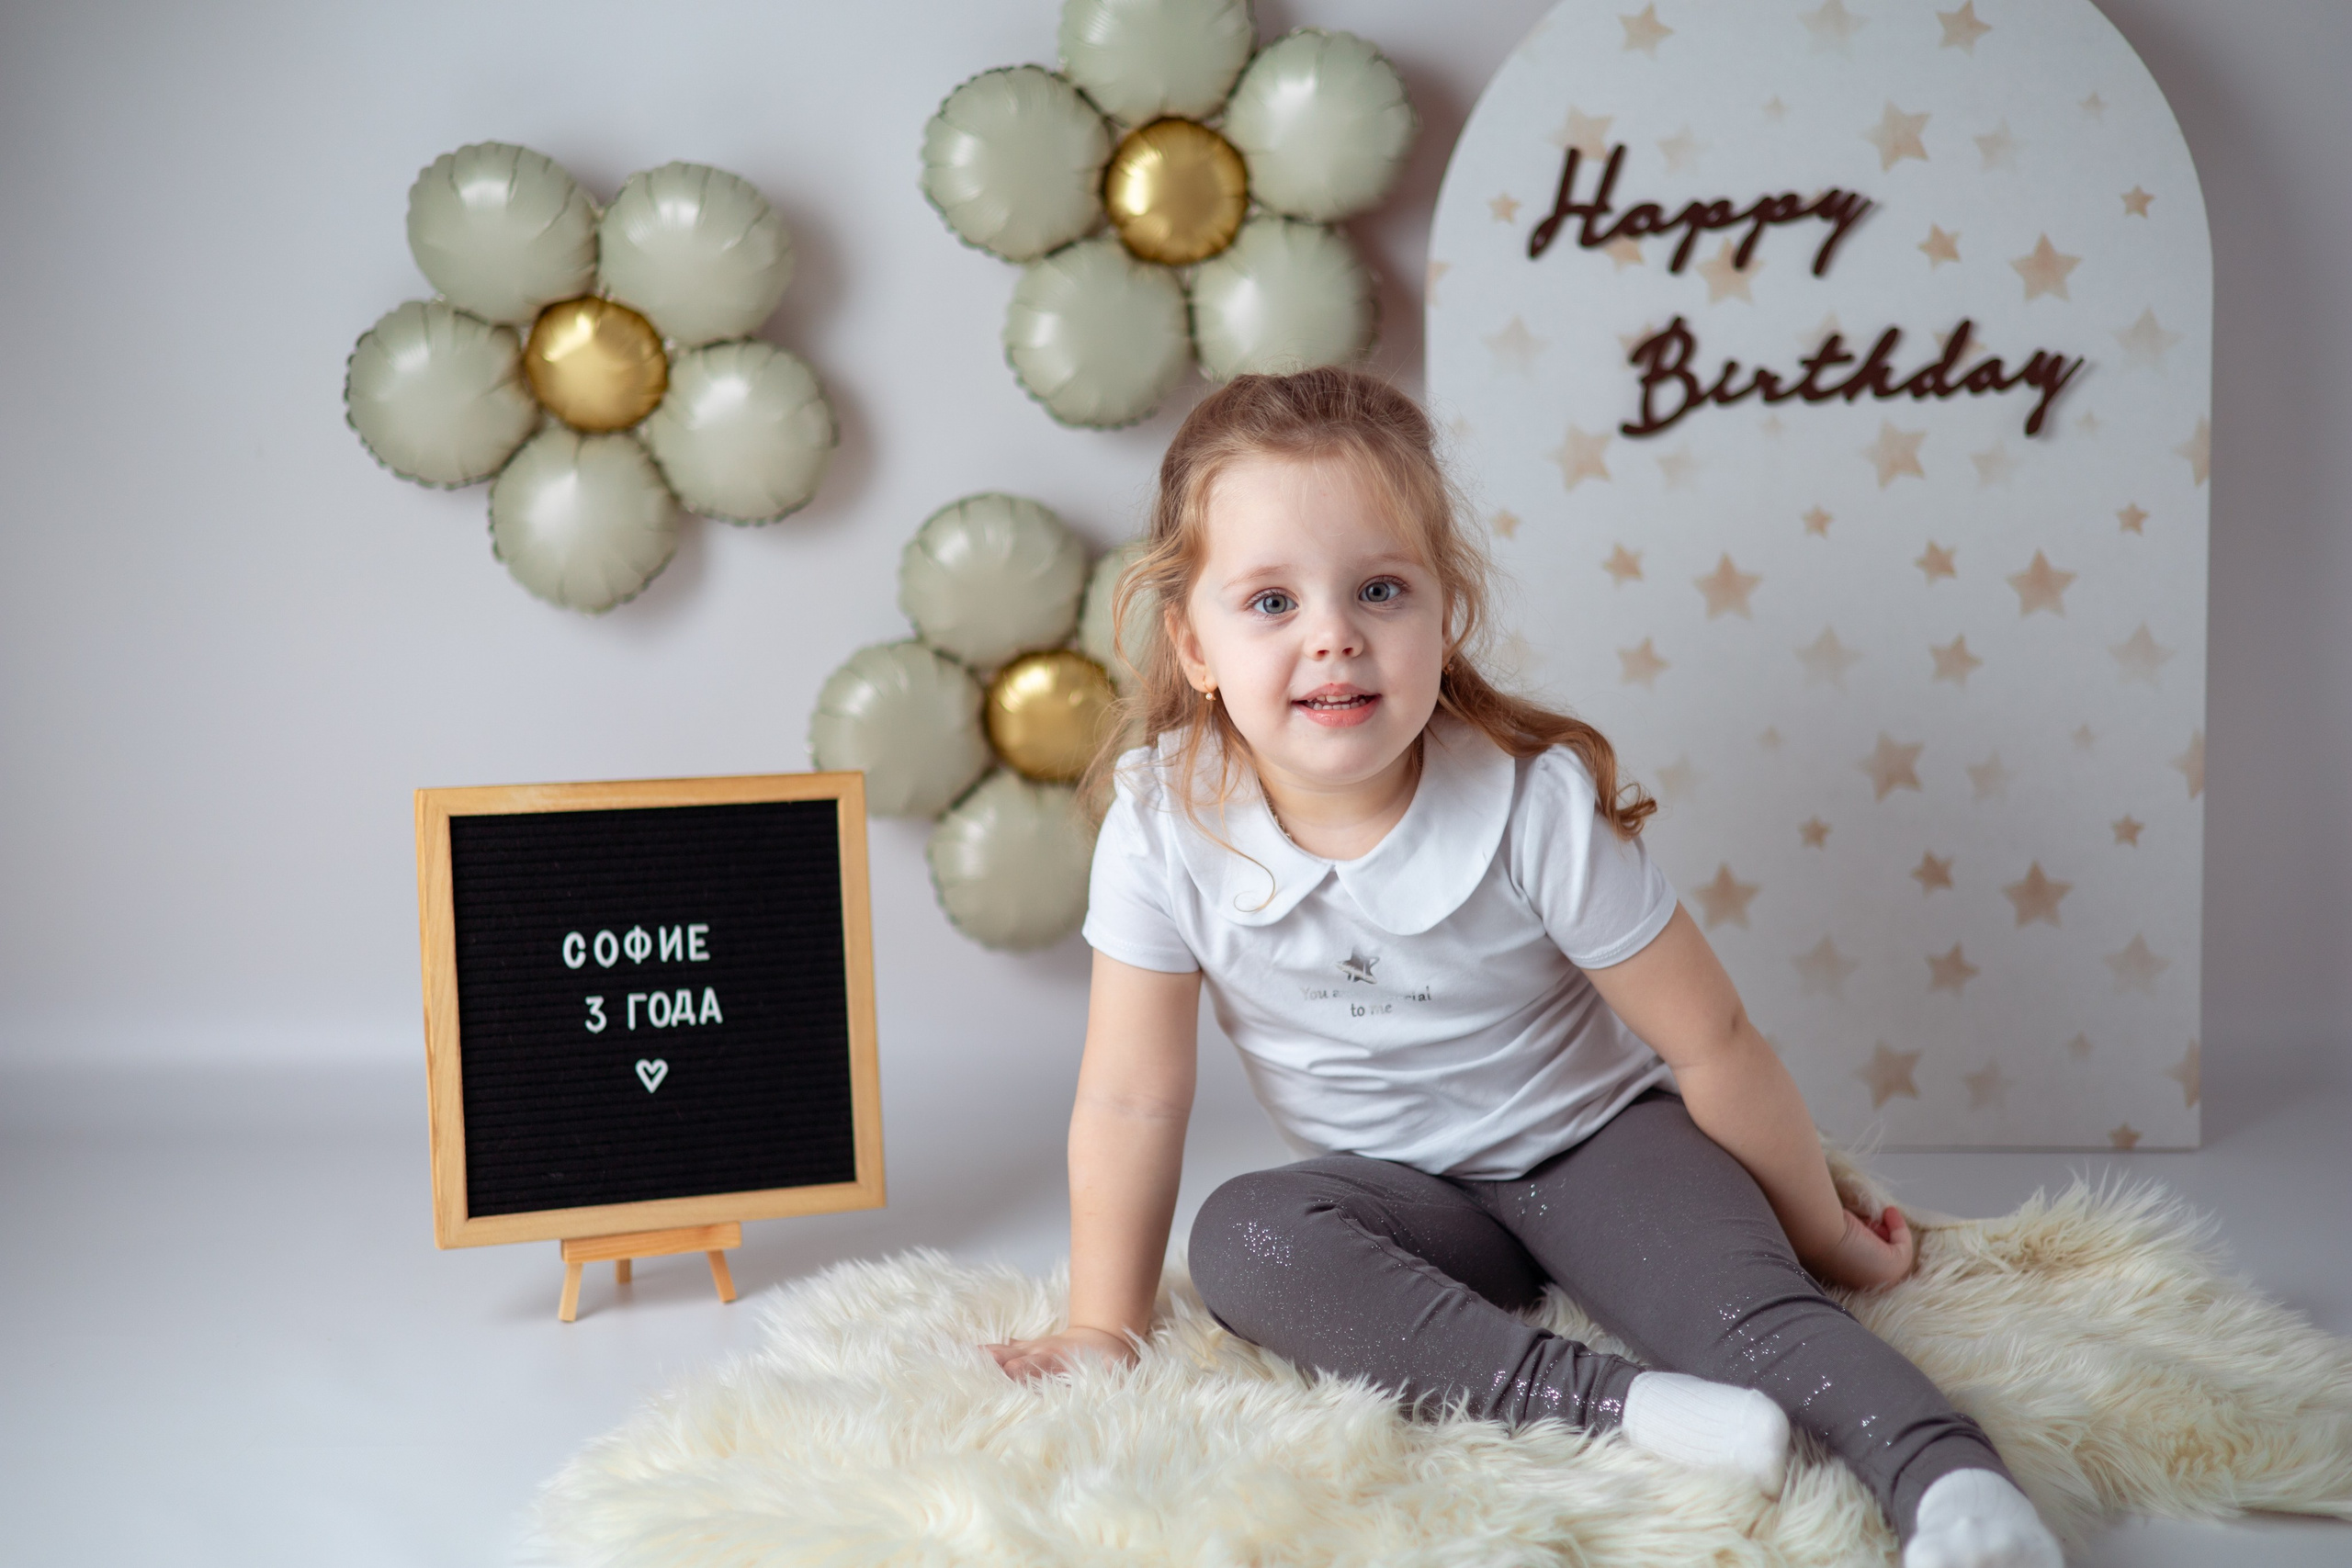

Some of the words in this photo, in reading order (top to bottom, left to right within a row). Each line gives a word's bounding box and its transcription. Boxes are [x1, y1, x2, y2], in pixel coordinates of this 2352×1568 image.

[1526, 142, 1876, 278] Happy
[1618, 314, 2086, 439] Birthday
[562, 924, 710, 969] СОФИЕ
[584, 996, 607, 1033] 3
[627, 987, 723, 1031] ГОДА
[1299, 987, 1329, 1001] You
[1351, 1002, 1365, 1018] to
[1370, 1003, 1393, 1016] me
